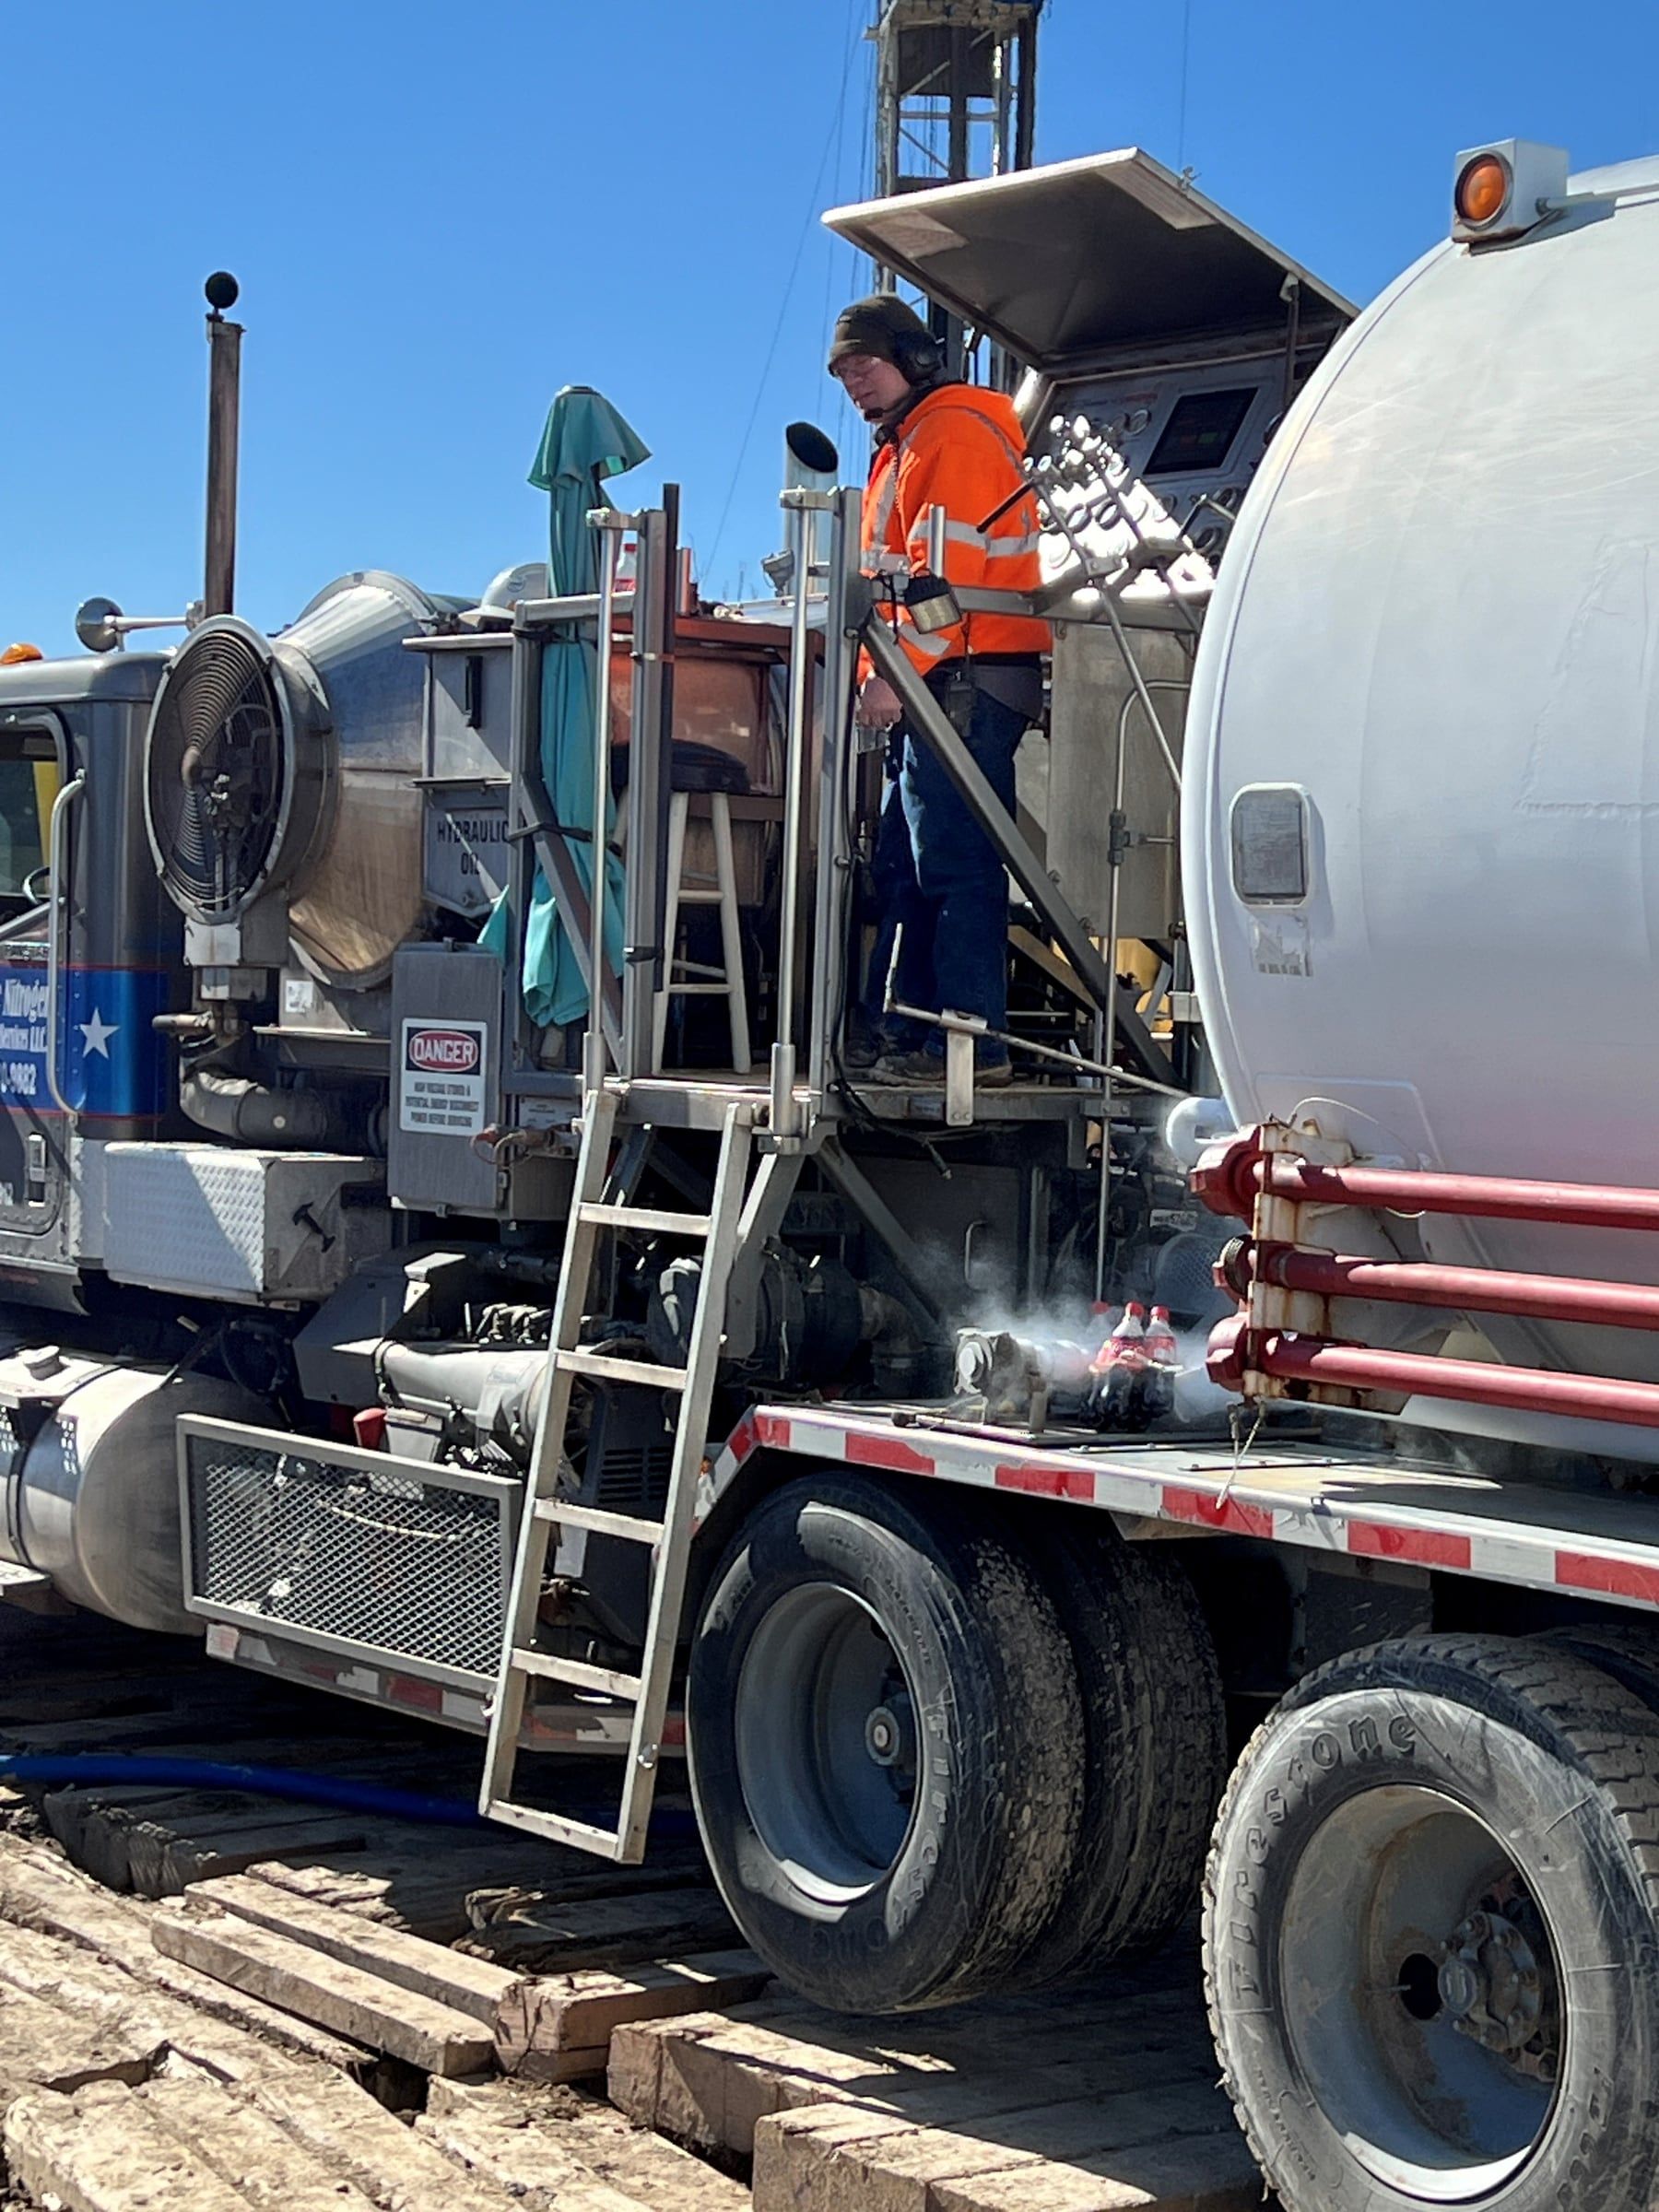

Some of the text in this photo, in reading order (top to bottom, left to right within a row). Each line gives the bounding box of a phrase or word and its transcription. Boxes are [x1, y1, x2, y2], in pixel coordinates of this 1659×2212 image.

[437, 819, 509, 843] HYDRAULIC
[414, 1038, 474, 1064] DANGER
[1226, 1712, 1418, 2001] Firestone
